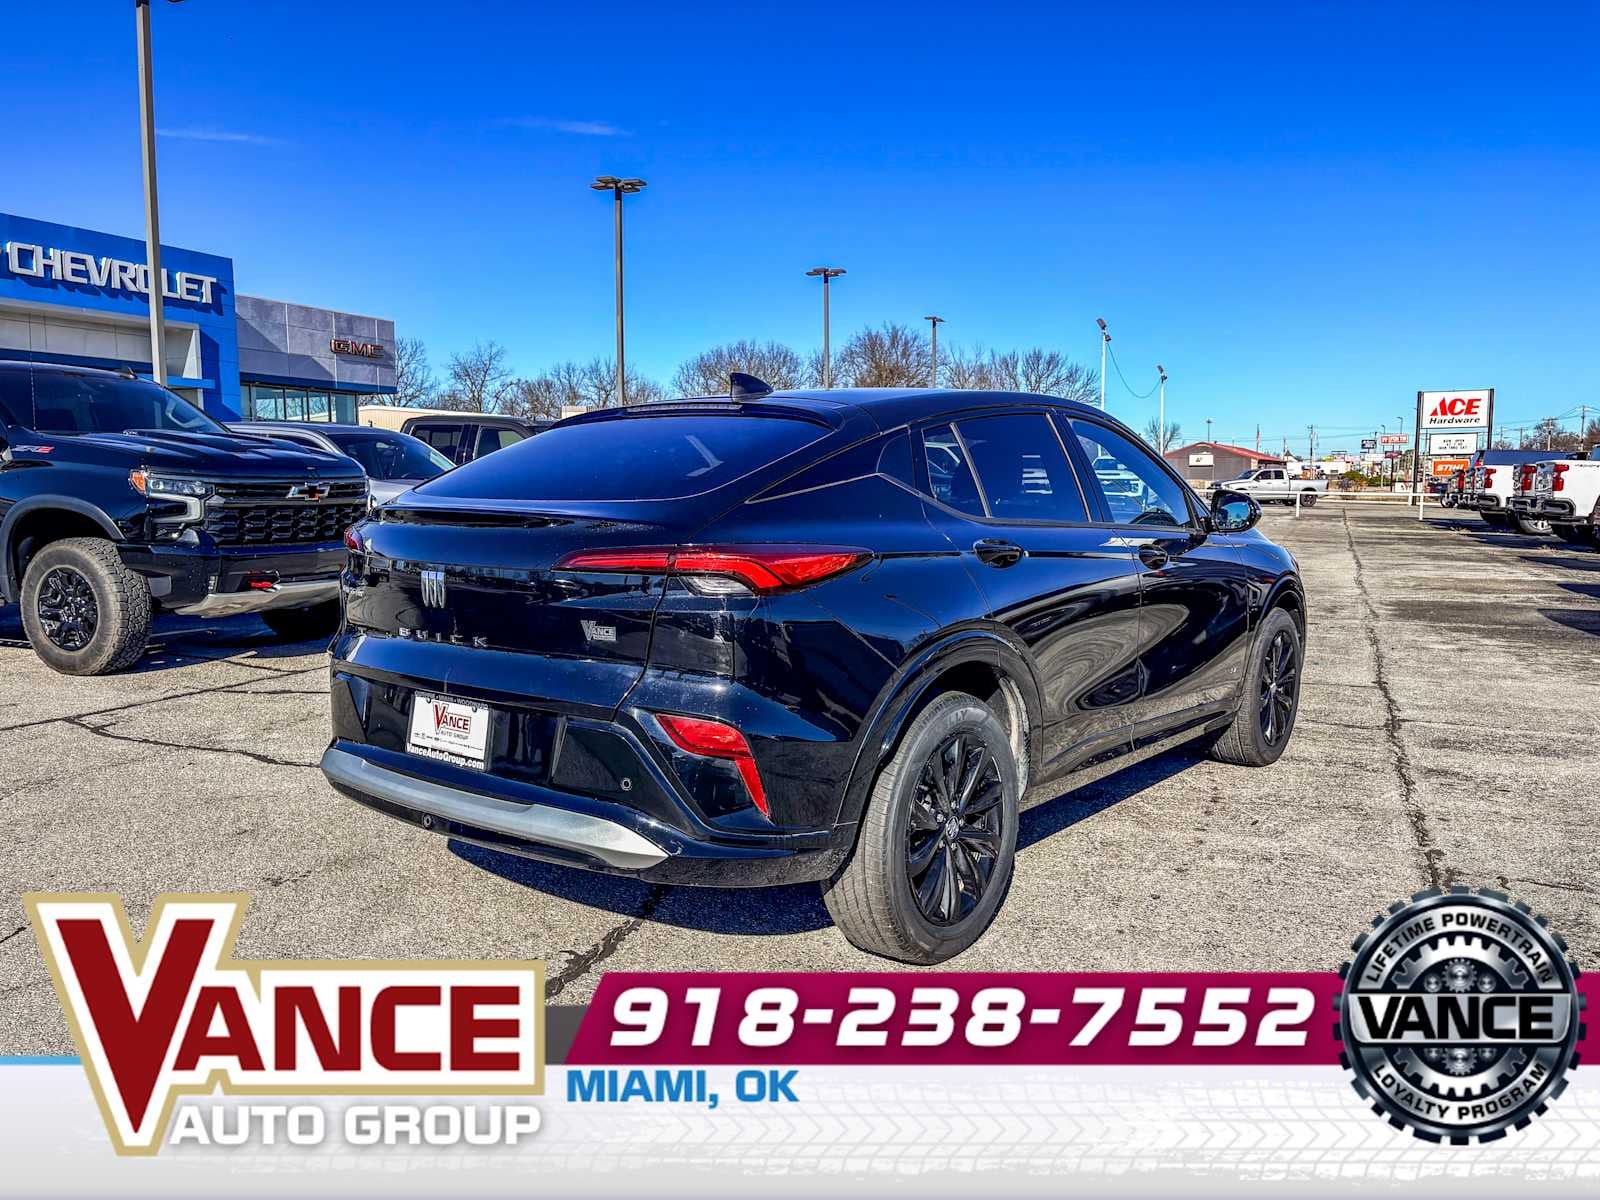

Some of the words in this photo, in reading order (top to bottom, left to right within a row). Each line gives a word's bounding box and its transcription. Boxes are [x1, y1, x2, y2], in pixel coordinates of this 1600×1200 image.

[7, 241, 217, 304] CHEVROLET
[331, 339, 384, 358] GMC
[1430, 397, 1482, 416] ACE
[1429, 417, 1481, 425] Hardware
[400, 627, 488, 648] BUICK
[433, 702, 470, 732] VANCE
[406, 742, 485, 770] VanceAutoGroup.com
